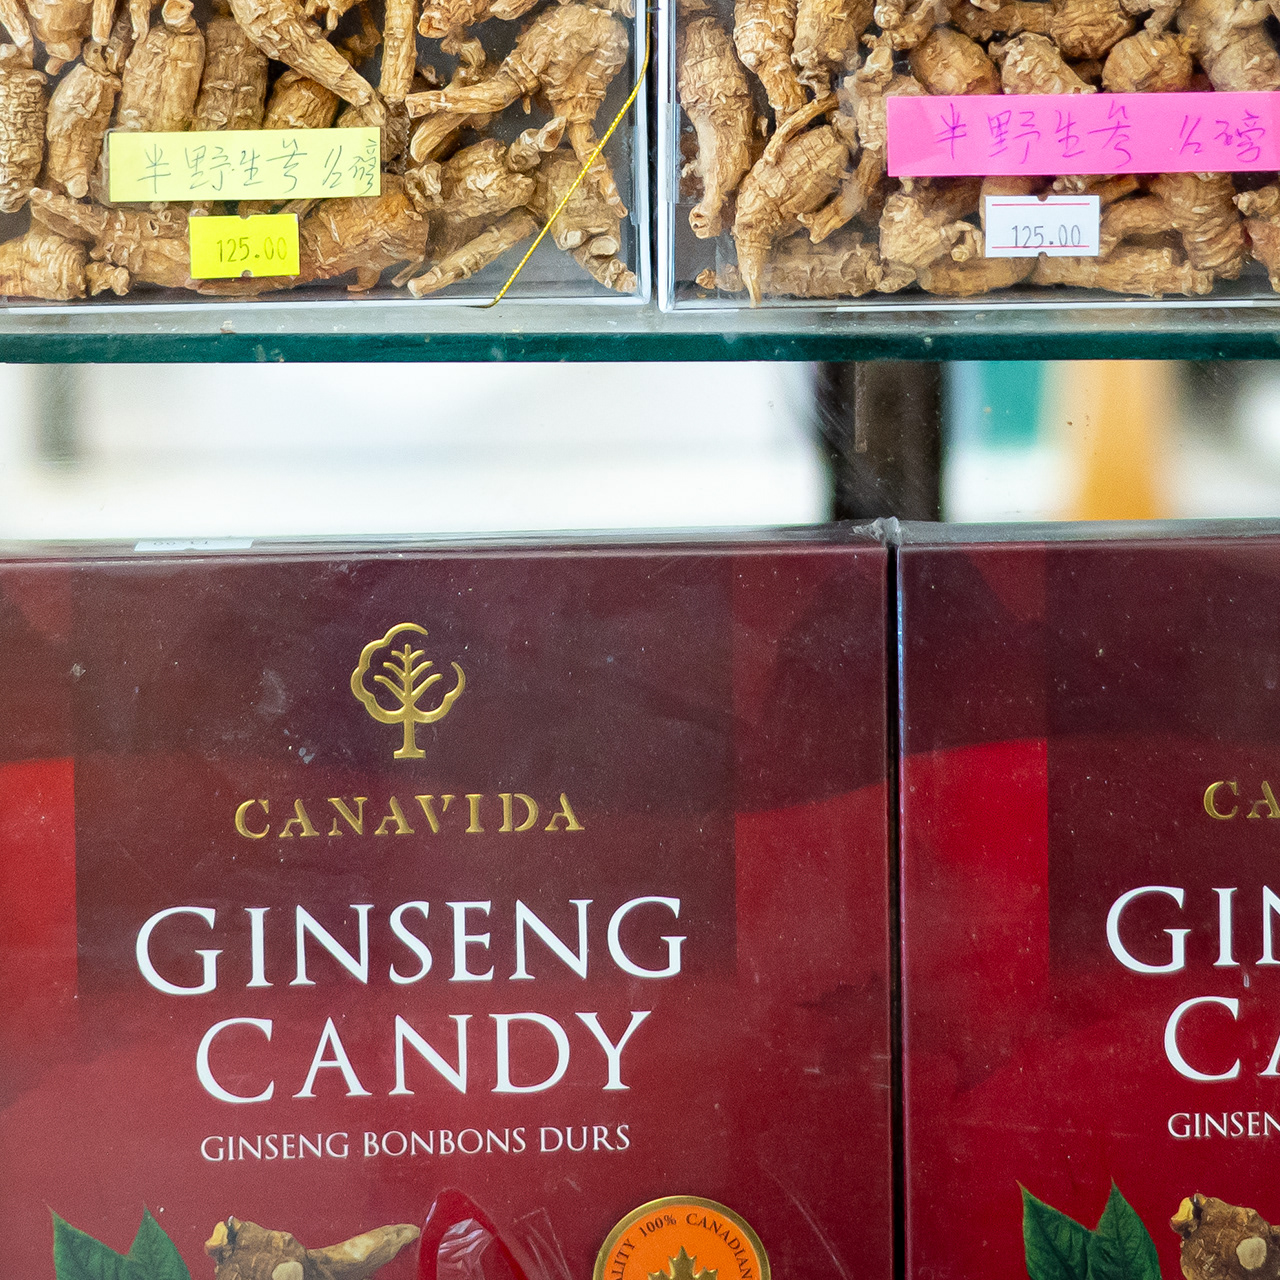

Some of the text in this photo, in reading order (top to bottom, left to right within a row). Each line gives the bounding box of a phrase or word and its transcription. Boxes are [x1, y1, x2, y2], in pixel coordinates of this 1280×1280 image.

[217, 236, 289, 263] 125.00
[1012, 224, 1081, 248] 125.00
[234, 792, 586, 839] CANAVIDA
[134, 895, 688, 997] GINSENG
[195, 1010, 652, 1105] CANDY
[200, 1123, 631, 1163] GINSENG BONBONS DURS
[611, 1212, 753, 1280] LITY 100% CANADIAN
